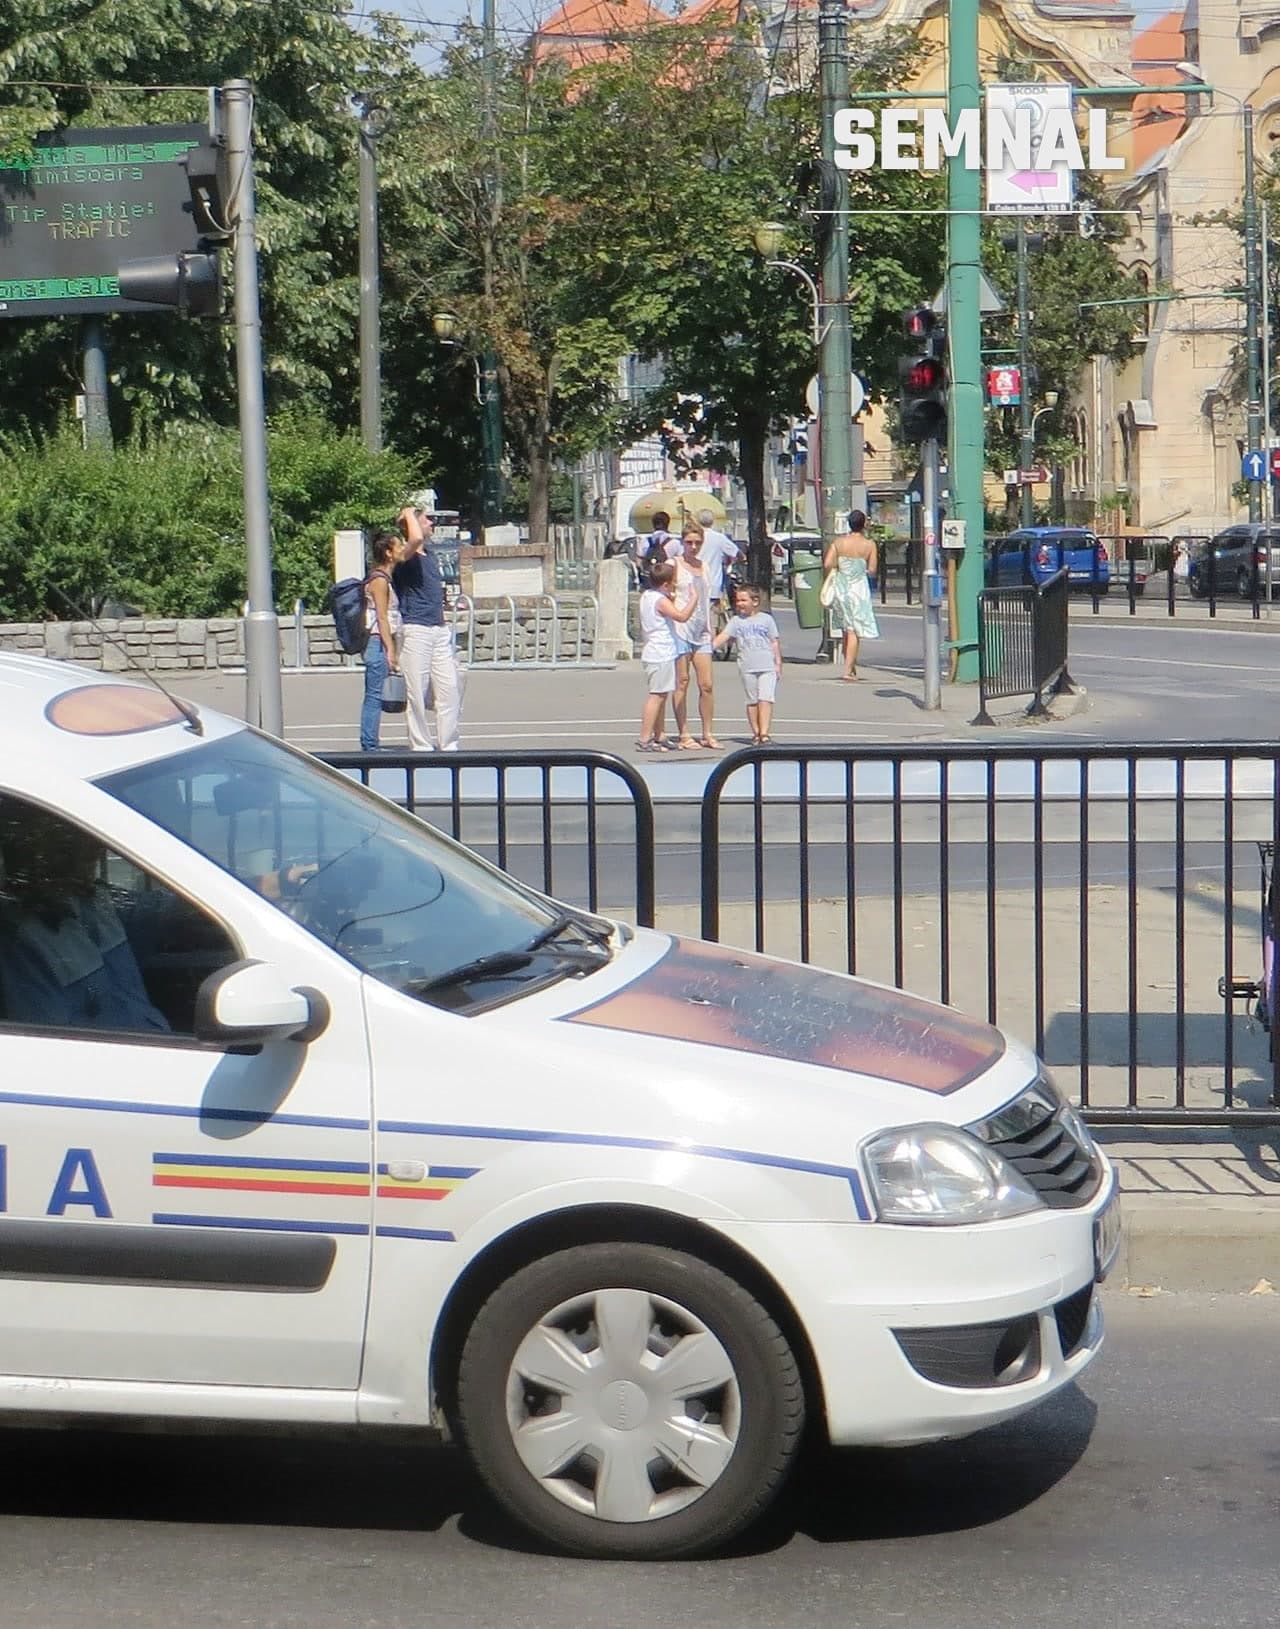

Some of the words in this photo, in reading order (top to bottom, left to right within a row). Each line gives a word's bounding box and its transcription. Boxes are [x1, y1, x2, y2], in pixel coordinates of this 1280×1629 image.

[19, 166, 143, 185] Timisoara
[6, 204, 47, 223] Tip
[62, 200, 154, 220] Statie:
[48, 219, 132, 240] TRAFIC
